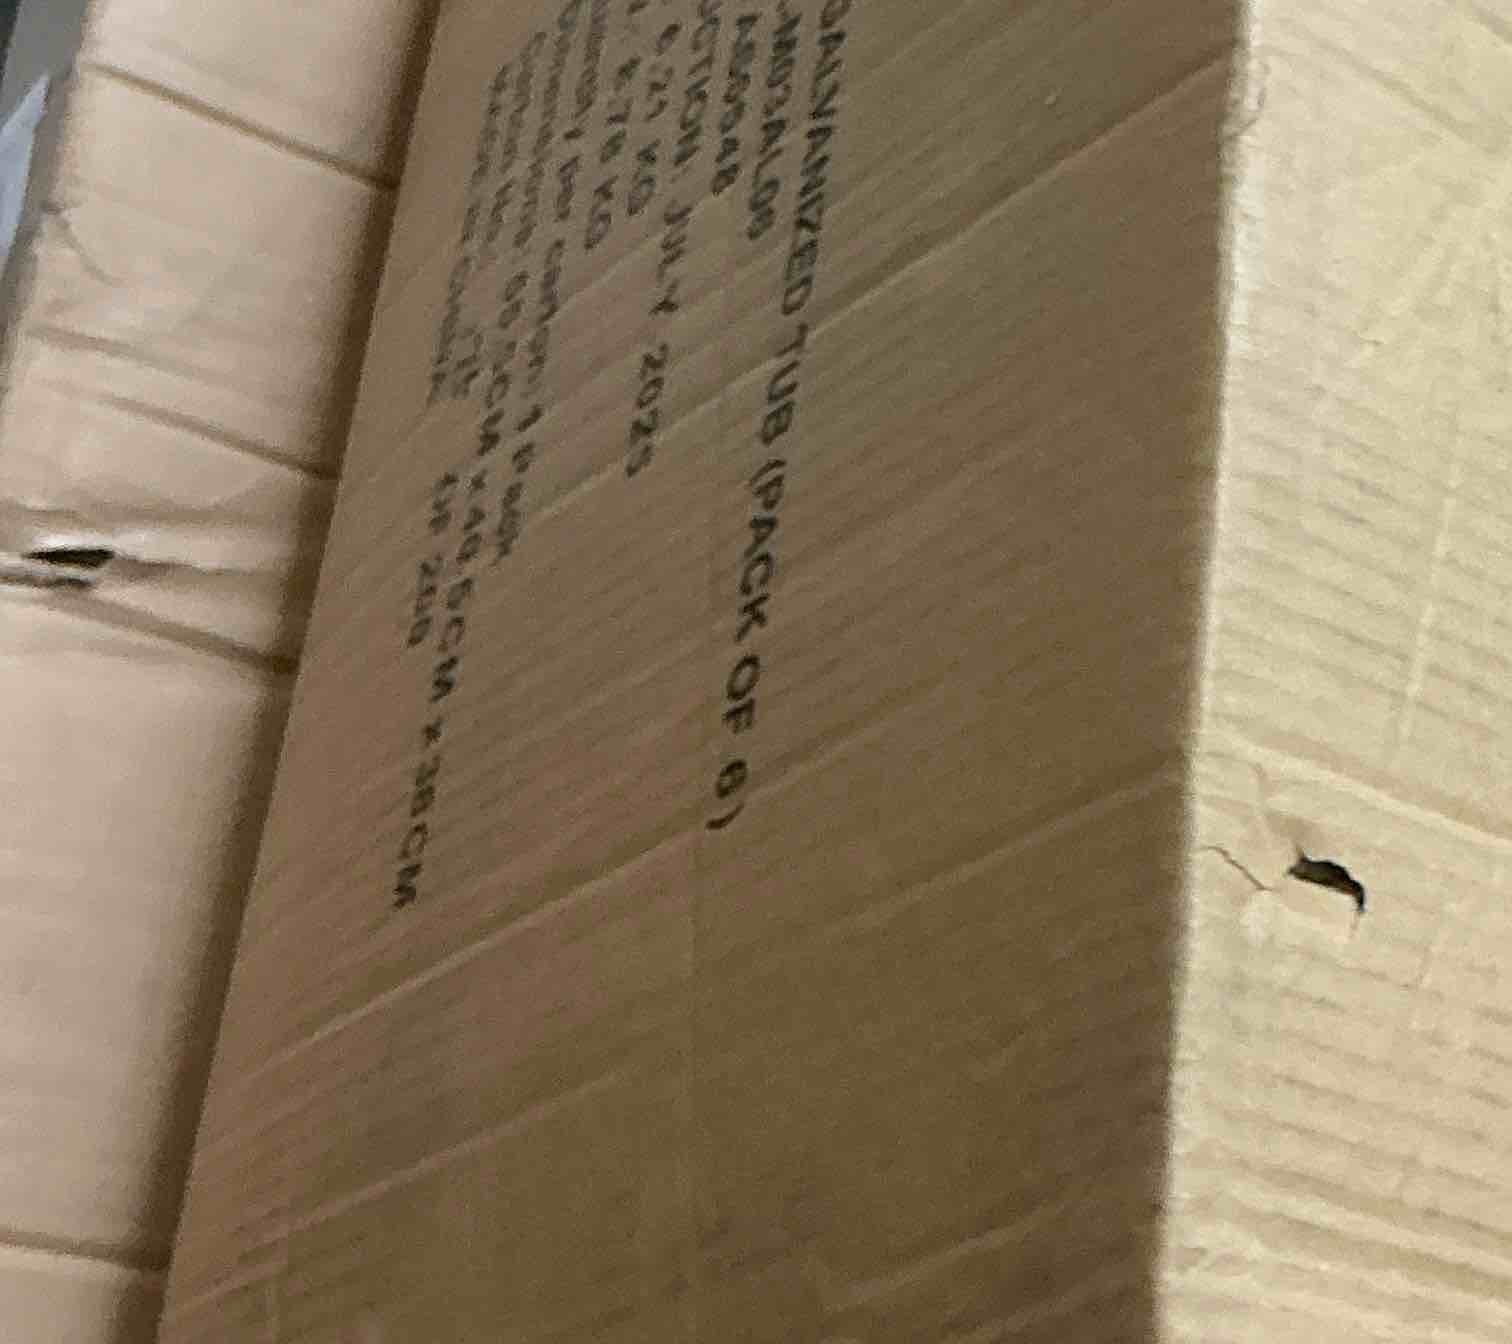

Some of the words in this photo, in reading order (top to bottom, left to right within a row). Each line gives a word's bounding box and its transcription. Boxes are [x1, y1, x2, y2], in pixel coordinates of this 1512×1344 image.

[649, 205, 691, 314] JULY
[759, 322, 808, 445] TUB
[735, 459, 785, 641] (PACK
[722, 653, 760, 733] OF
